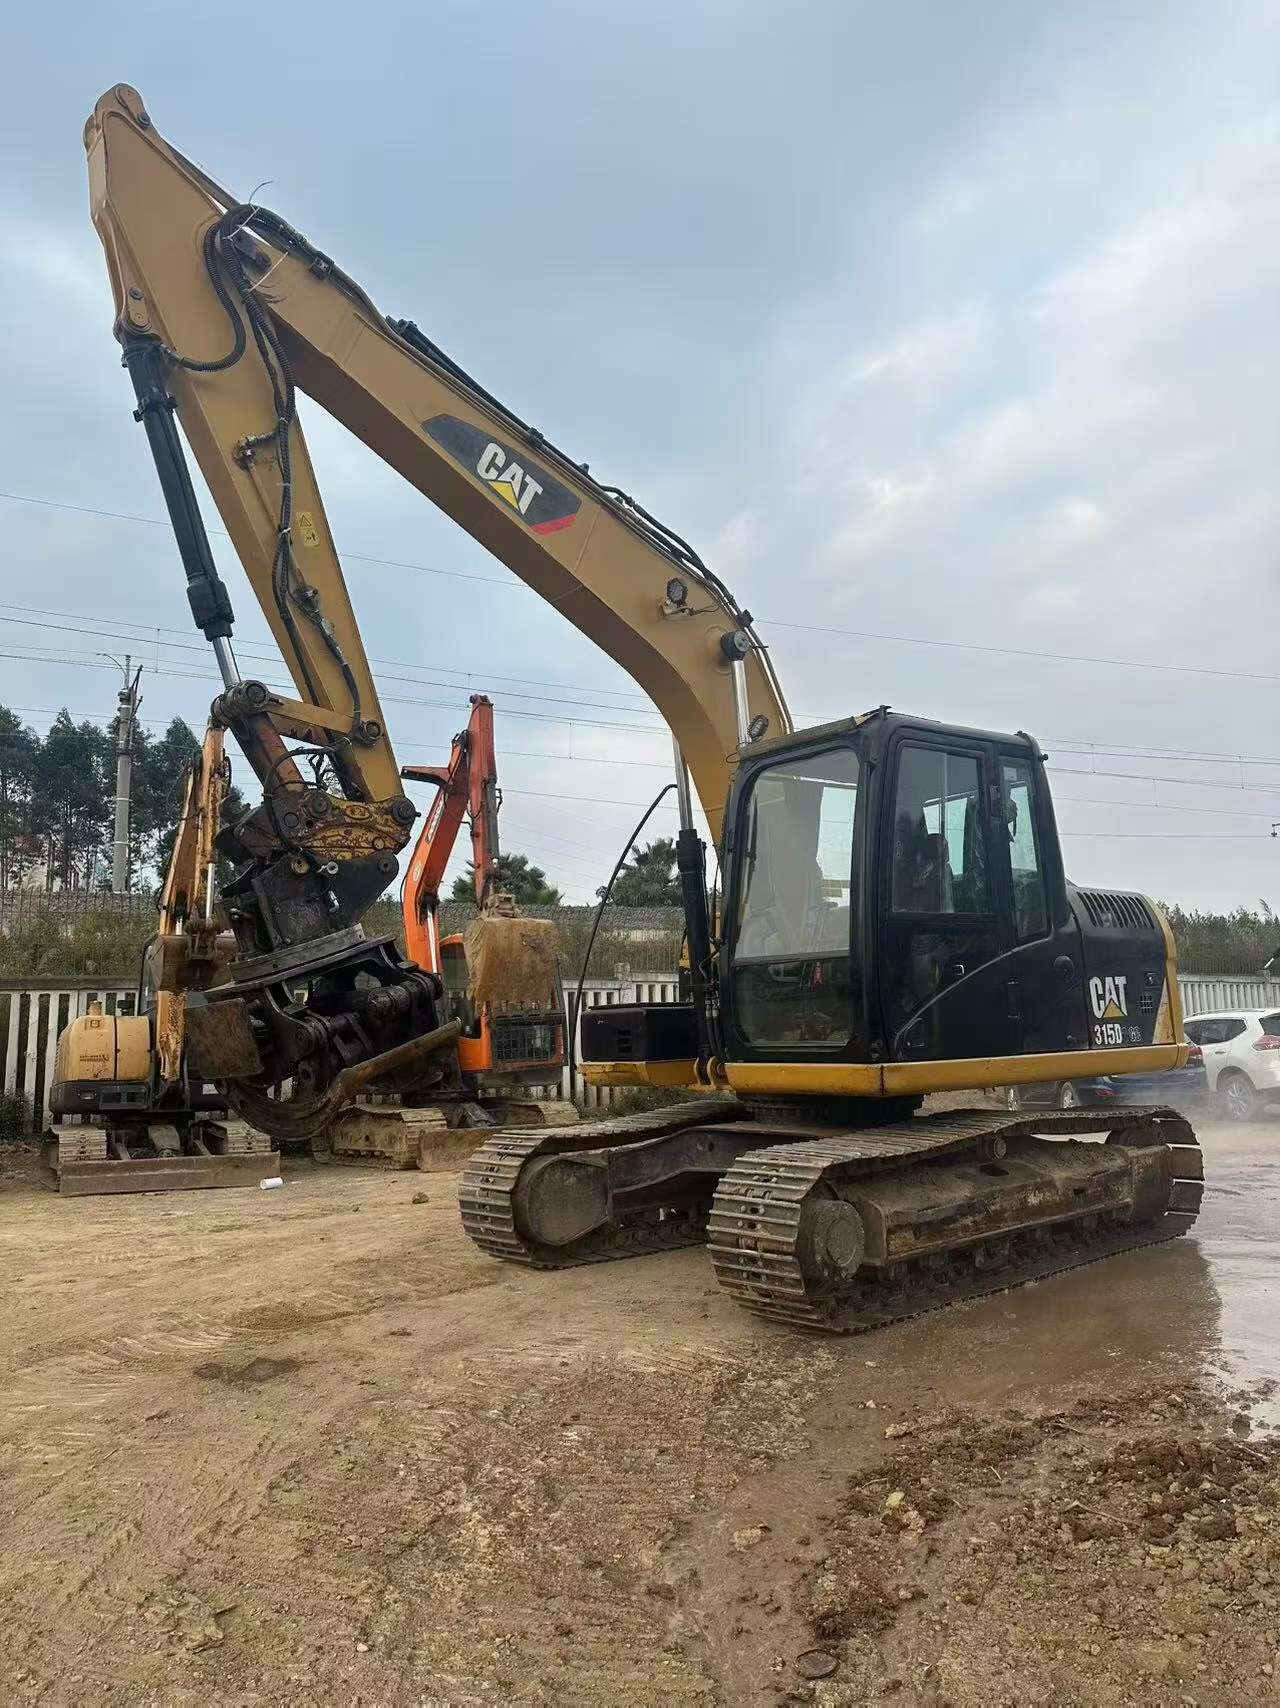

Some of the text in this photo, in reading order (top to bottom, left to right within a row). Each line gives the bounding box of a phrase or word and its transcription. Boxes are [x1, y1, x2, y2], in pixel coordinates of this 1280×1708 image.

[477, 442, 543, 515] CAT
[1089, 976, 1128, 1019] CAT
[1094, 1023, 1123, 1045] 315D
